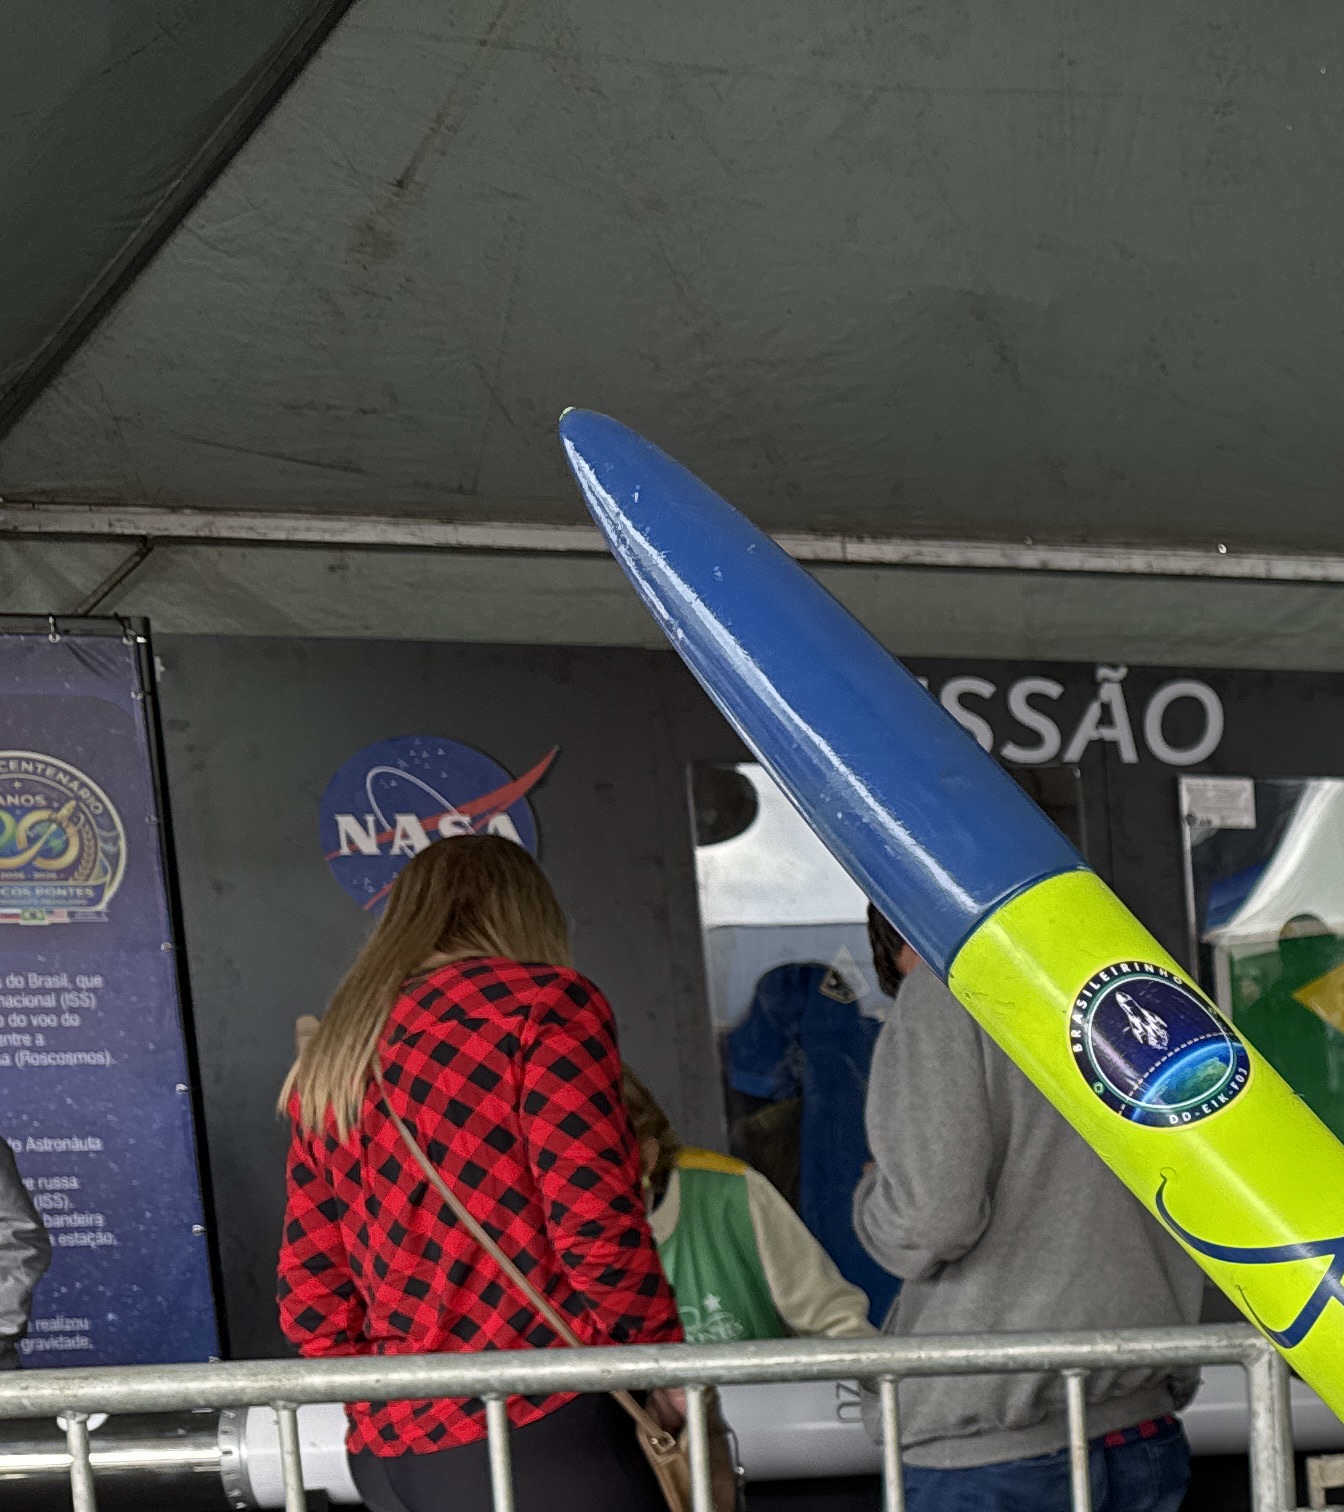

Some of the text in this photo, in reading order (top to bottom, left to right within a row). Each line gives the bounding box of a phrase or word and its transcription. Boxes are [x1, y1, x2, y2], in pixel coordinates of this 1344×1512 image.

[917, 665, 1225, 767] SSÃO
[334, 812, 525, 857] NASA
[60, 990, 97, 1011] (ISS)
[75, 974, 103, 991] que
[1071, 961, 1182, 1054] BRASILEIRINHO
